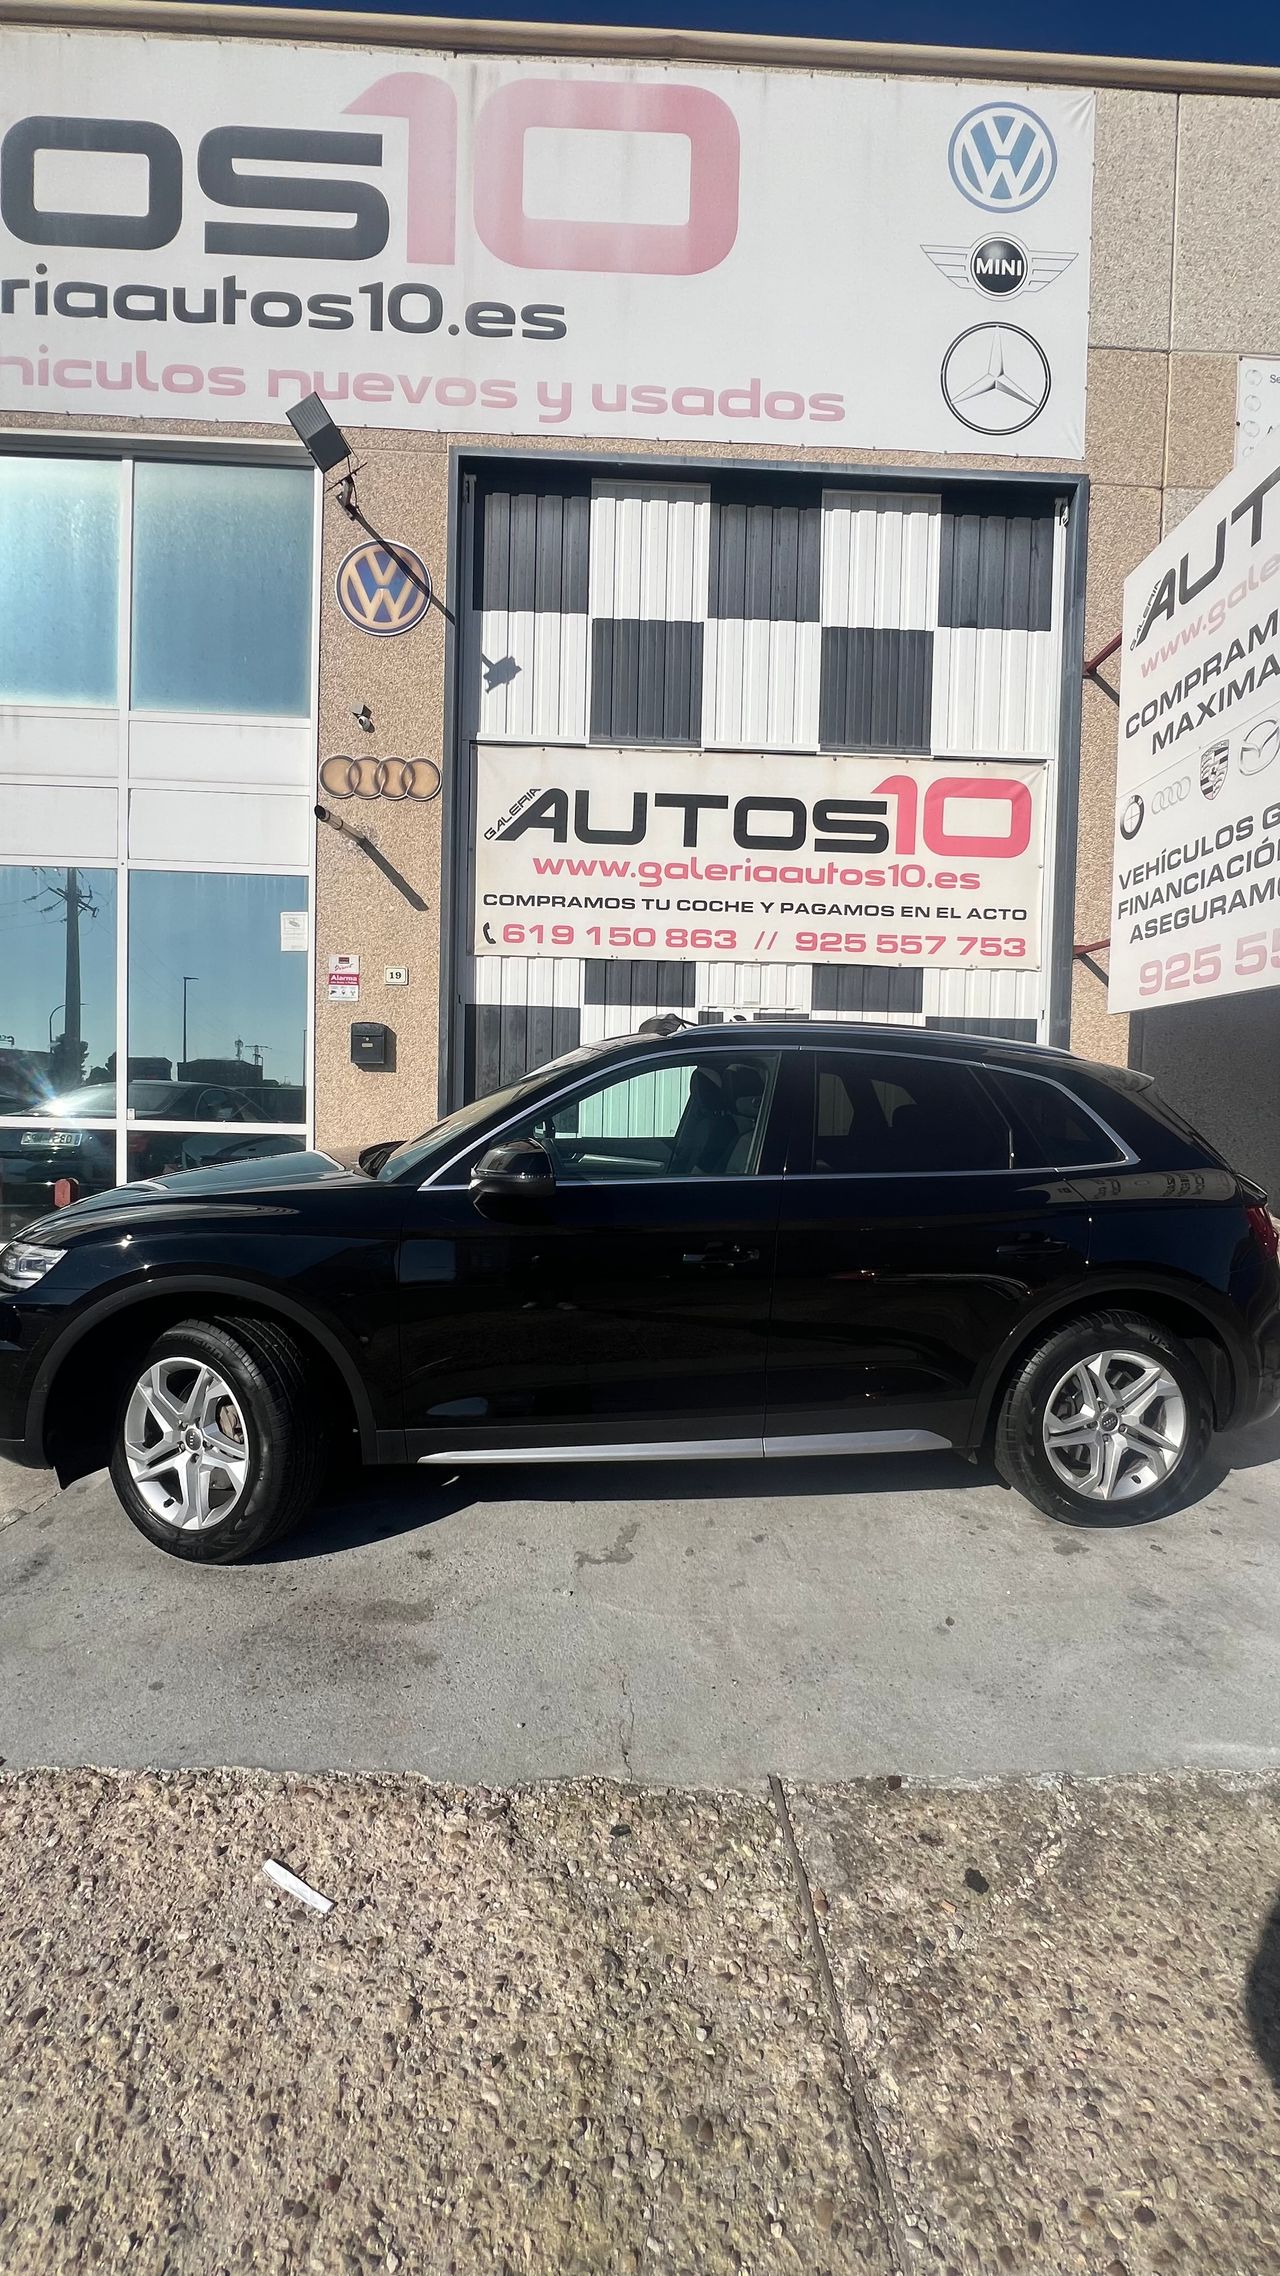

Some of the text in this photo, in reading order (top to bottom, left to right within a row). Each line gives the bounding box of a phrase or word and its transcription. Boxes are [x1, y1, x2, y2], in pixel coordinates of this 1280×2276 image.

[976, 257, 1022, 276] MINI
[1, 263, 568, 340] riaautos10.es
[268, 368, 518, 410] nuevos
[537, 381, 572, 423] y
[592, 378, 846, 422] usados
[1126, 608, 1279, 740] COMPRAM
[483, 788, 541, 841] GALERIA
[494, 775, 1032, 859] AUTOS10
[532, 856, 981, 890] www.galeriaautos10.es
[1118, 836, 1280, 920] FINANCIACIÓ
[1119, 815, 1253, 890] VEHÍCULOS
[483, 894, 1027, 921] COMPRAMOS TU COCHE Y PAGAMOS EN EL ACTO
[1130, 877, 1280, 944] ASEGURAM
[502, 923, 575, 945] 619
[586, 926, 656, 947] 150
[665, 928, 737, 949] 863
[795, 932, 866, 953] 925
[876, 934, 946, 955] 557
[957, 936, 1026, 957] 753
[330, 974, 358, 982] Alarma
[389, 971, 402, 980] 19
[1139, 943, 1222, 997] 925
